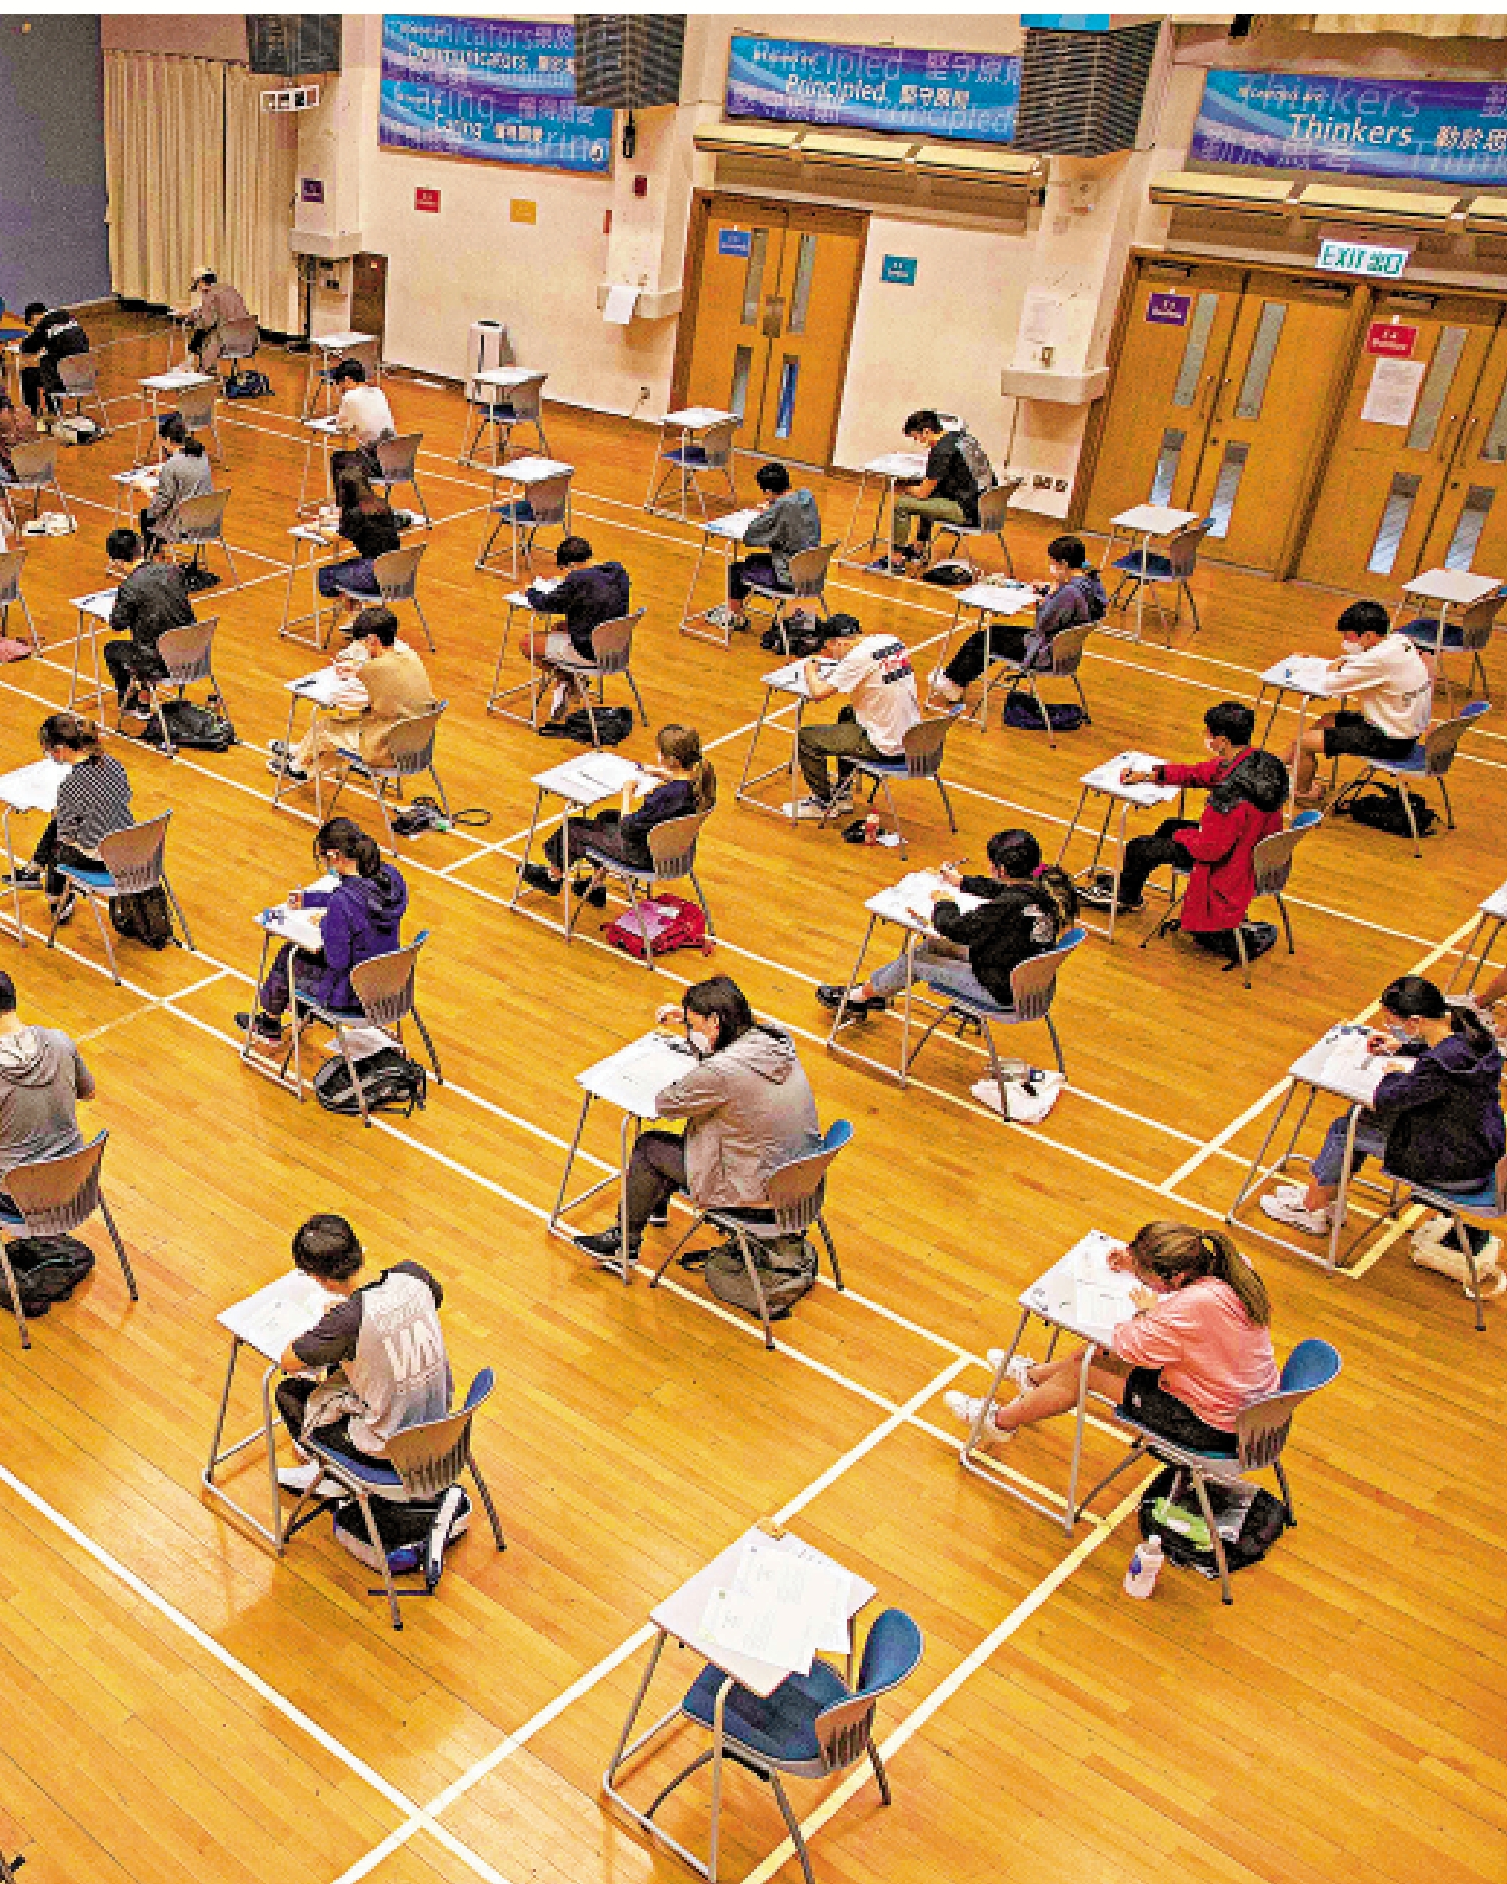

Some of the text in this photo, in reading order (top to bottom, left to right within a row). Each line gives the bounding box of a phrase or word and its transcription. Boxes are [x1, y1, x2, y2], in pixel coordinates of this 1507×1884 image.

[785, 73, 887, 104] Principled
[435, 113, 482, 139] Caring
[1288, 112, 1415, 146] Thinkers
[1321, 244, 1404, 275] EXIT 出口
